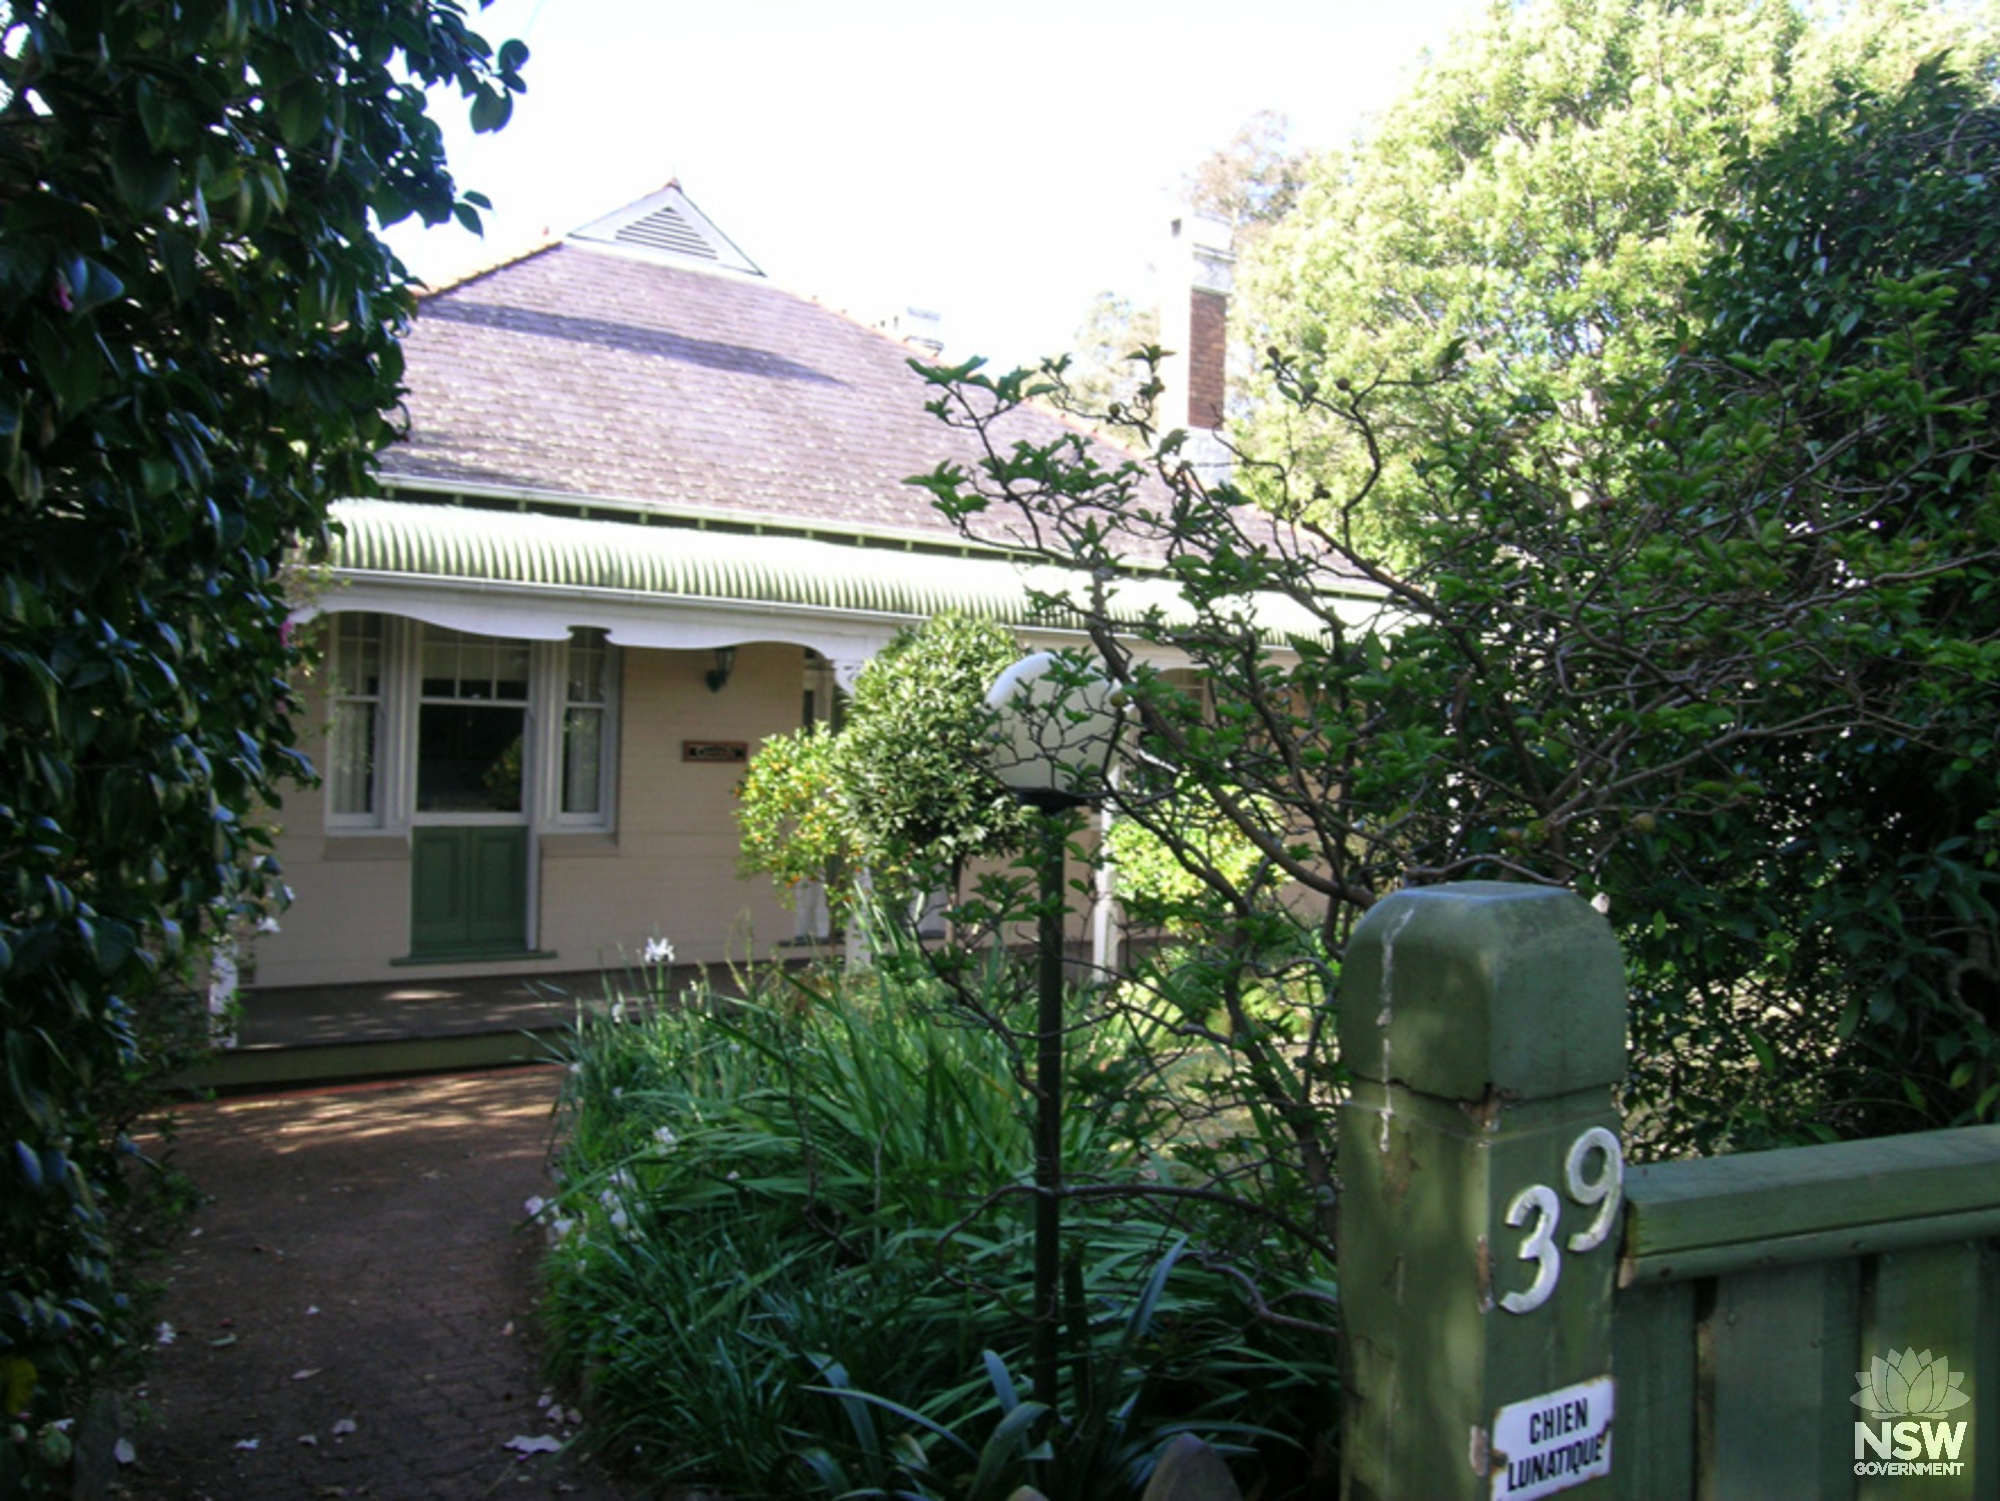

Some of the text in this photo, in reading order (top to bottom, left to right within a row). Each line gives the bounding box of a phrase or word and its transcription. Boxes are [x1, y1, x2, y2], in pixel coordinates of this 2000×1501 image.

[1500, 1126, 1623, 1313] 39
[1530, 1398, 1588, 1445] CHIEN
[1507, 1435, 1604, 1492] LUNATIQUE
